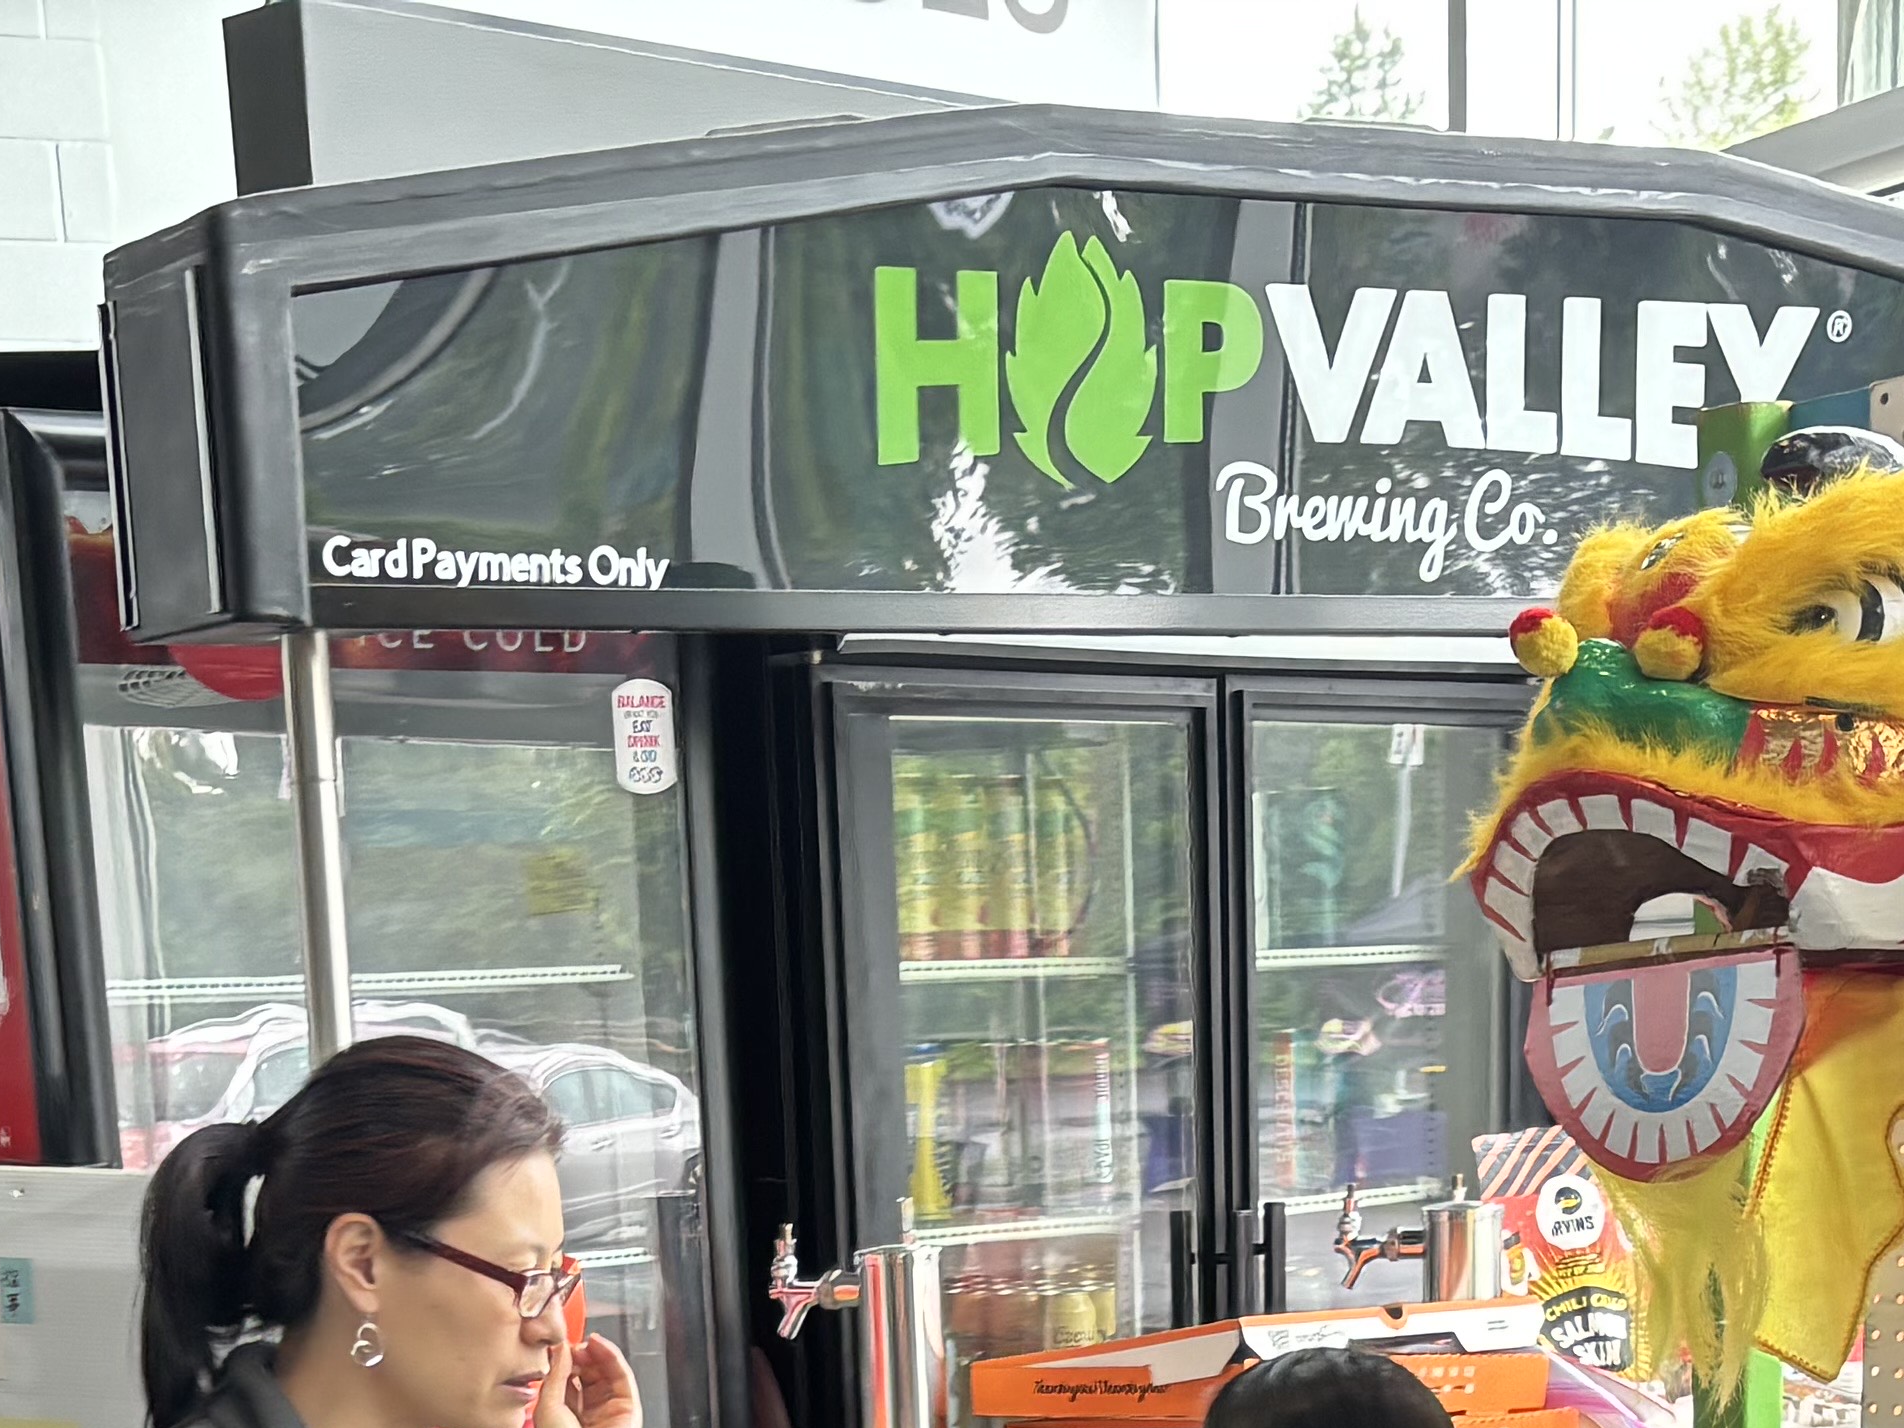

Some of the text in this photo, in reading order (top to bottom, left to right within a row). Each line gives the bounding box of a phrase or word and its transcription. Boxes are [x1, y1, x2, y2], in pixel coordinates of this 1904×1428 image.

[322, 535, 671, 591] Card Payments Only
[1215, 461, 1559, 582] Brewing Co.
